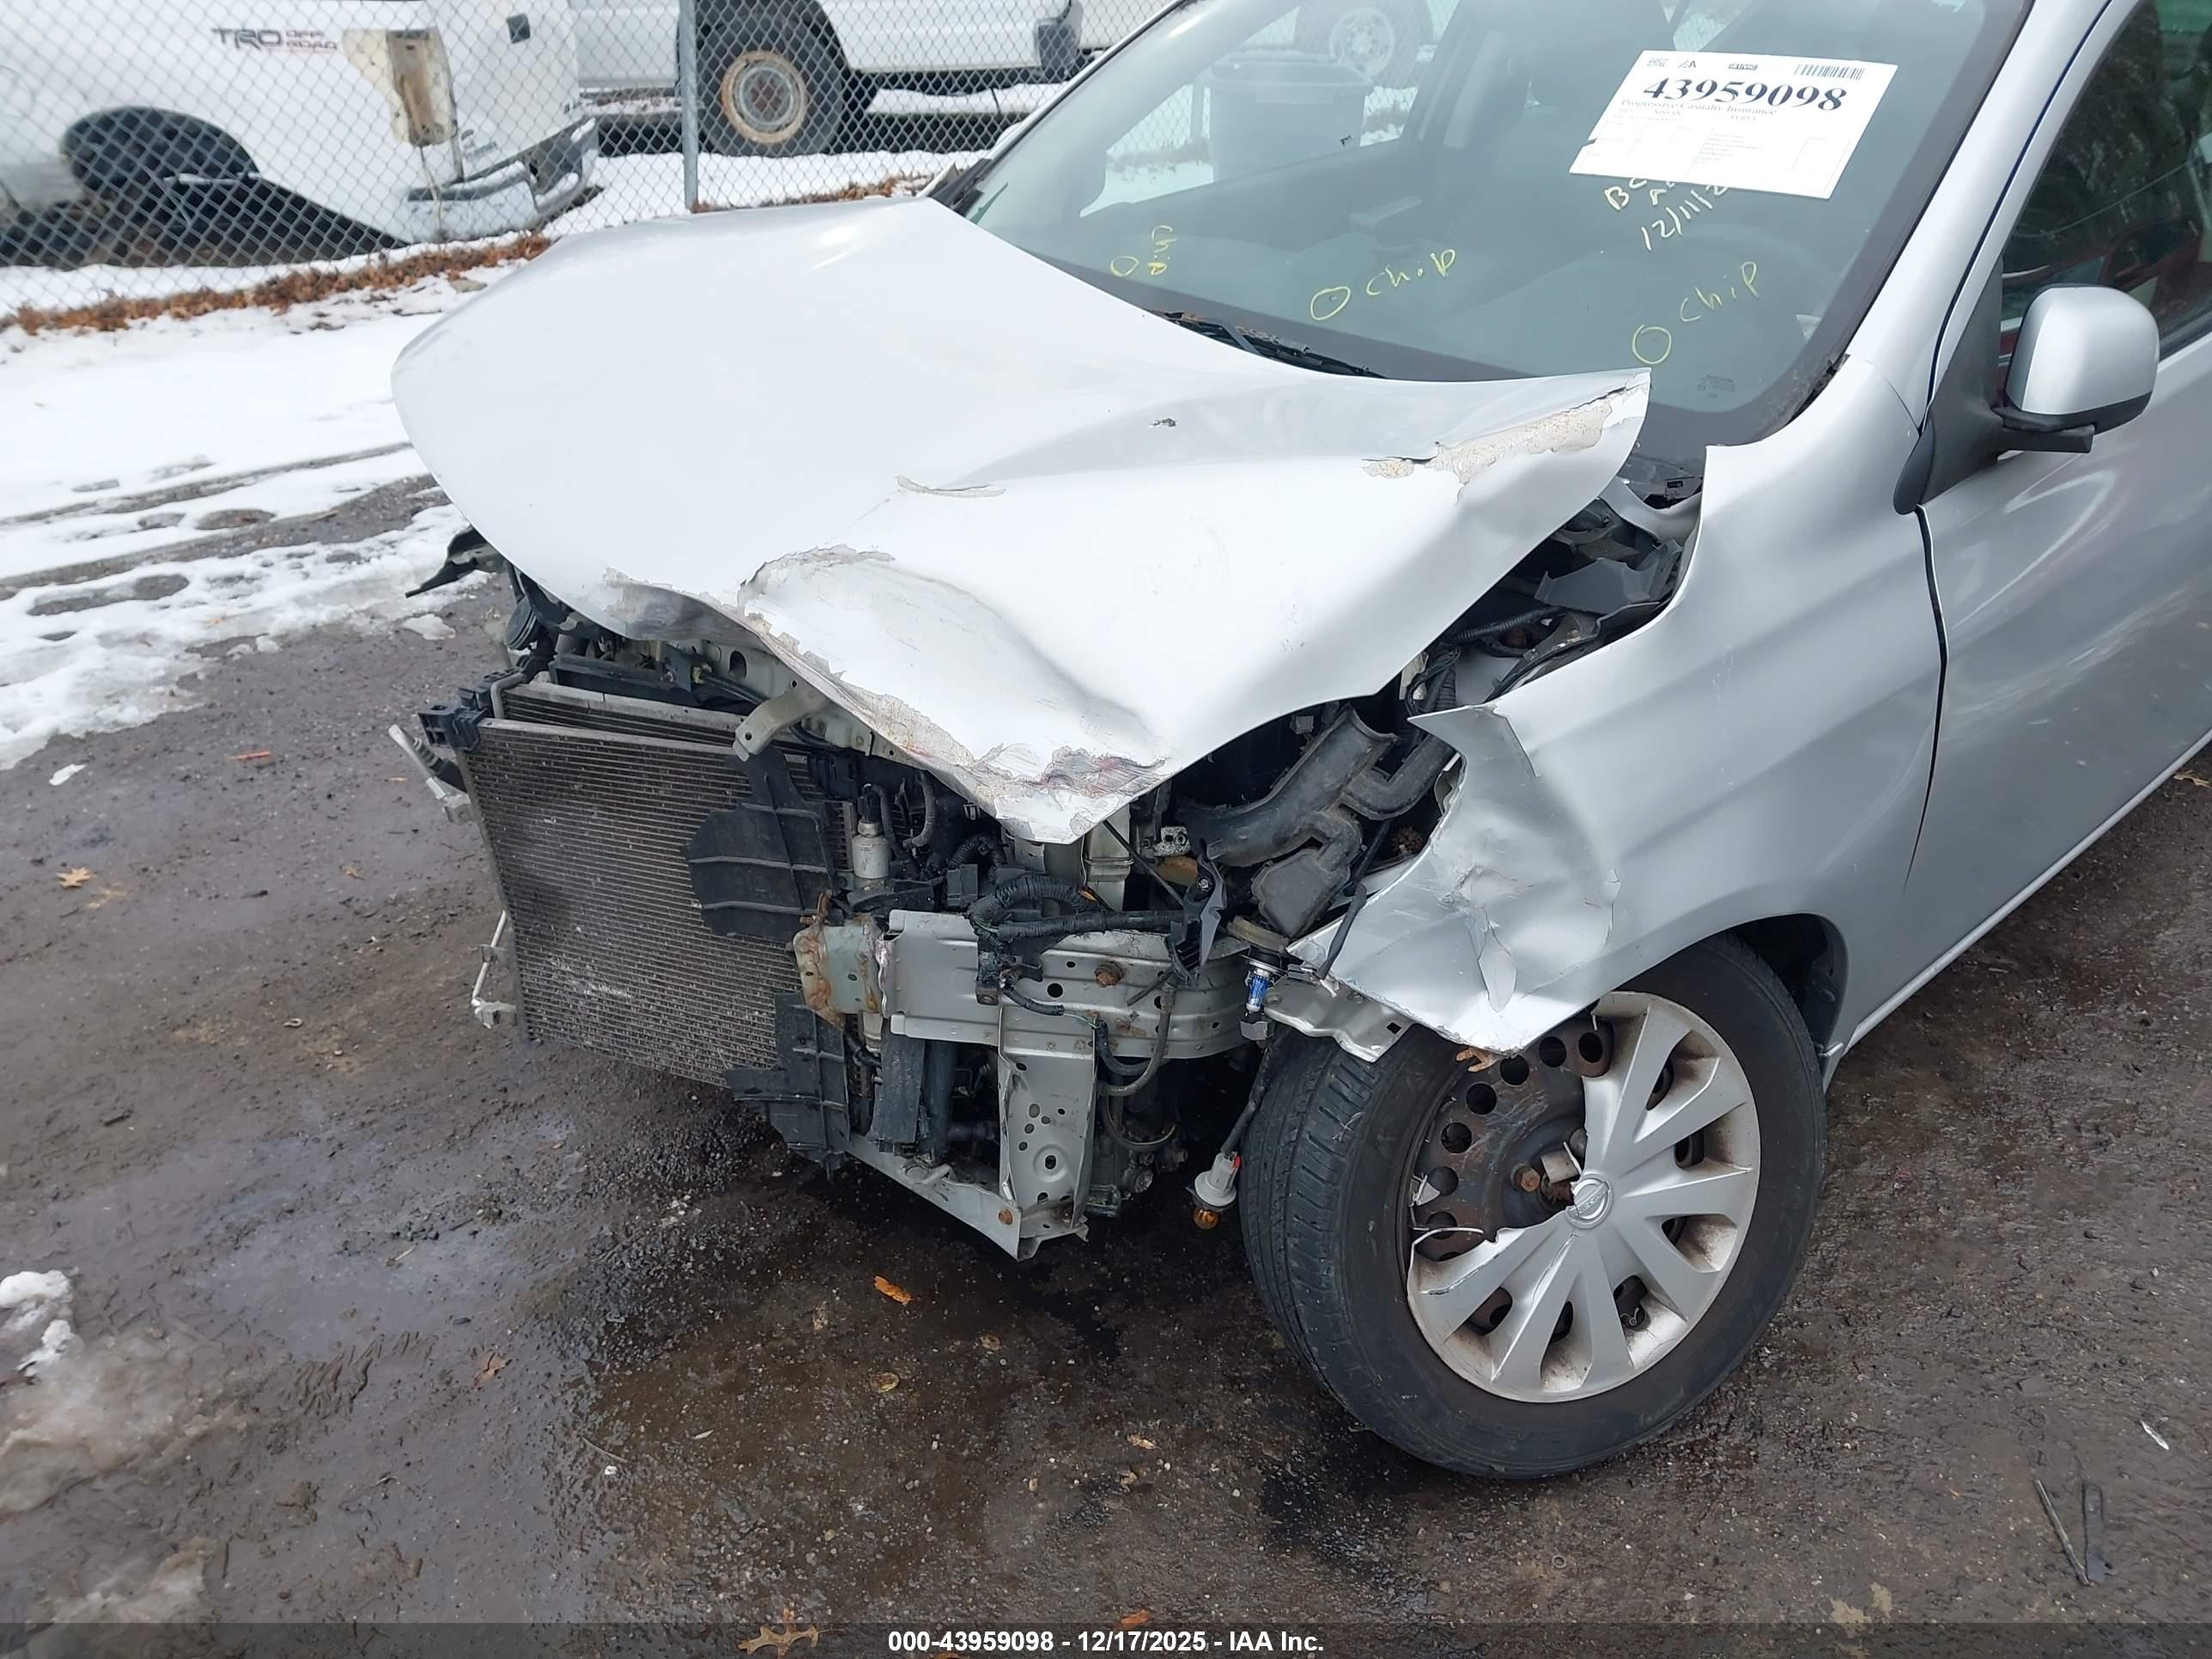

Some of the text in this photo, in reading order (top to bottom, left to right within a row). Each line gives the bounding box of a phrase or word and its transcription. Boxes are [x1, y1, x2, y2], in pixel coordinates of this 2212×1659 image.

[1643, 77, 1848, 111] 43959098
[1621, 99, 1678, 110] Progressive
[1726, 105, 1778, 116] Insurance
